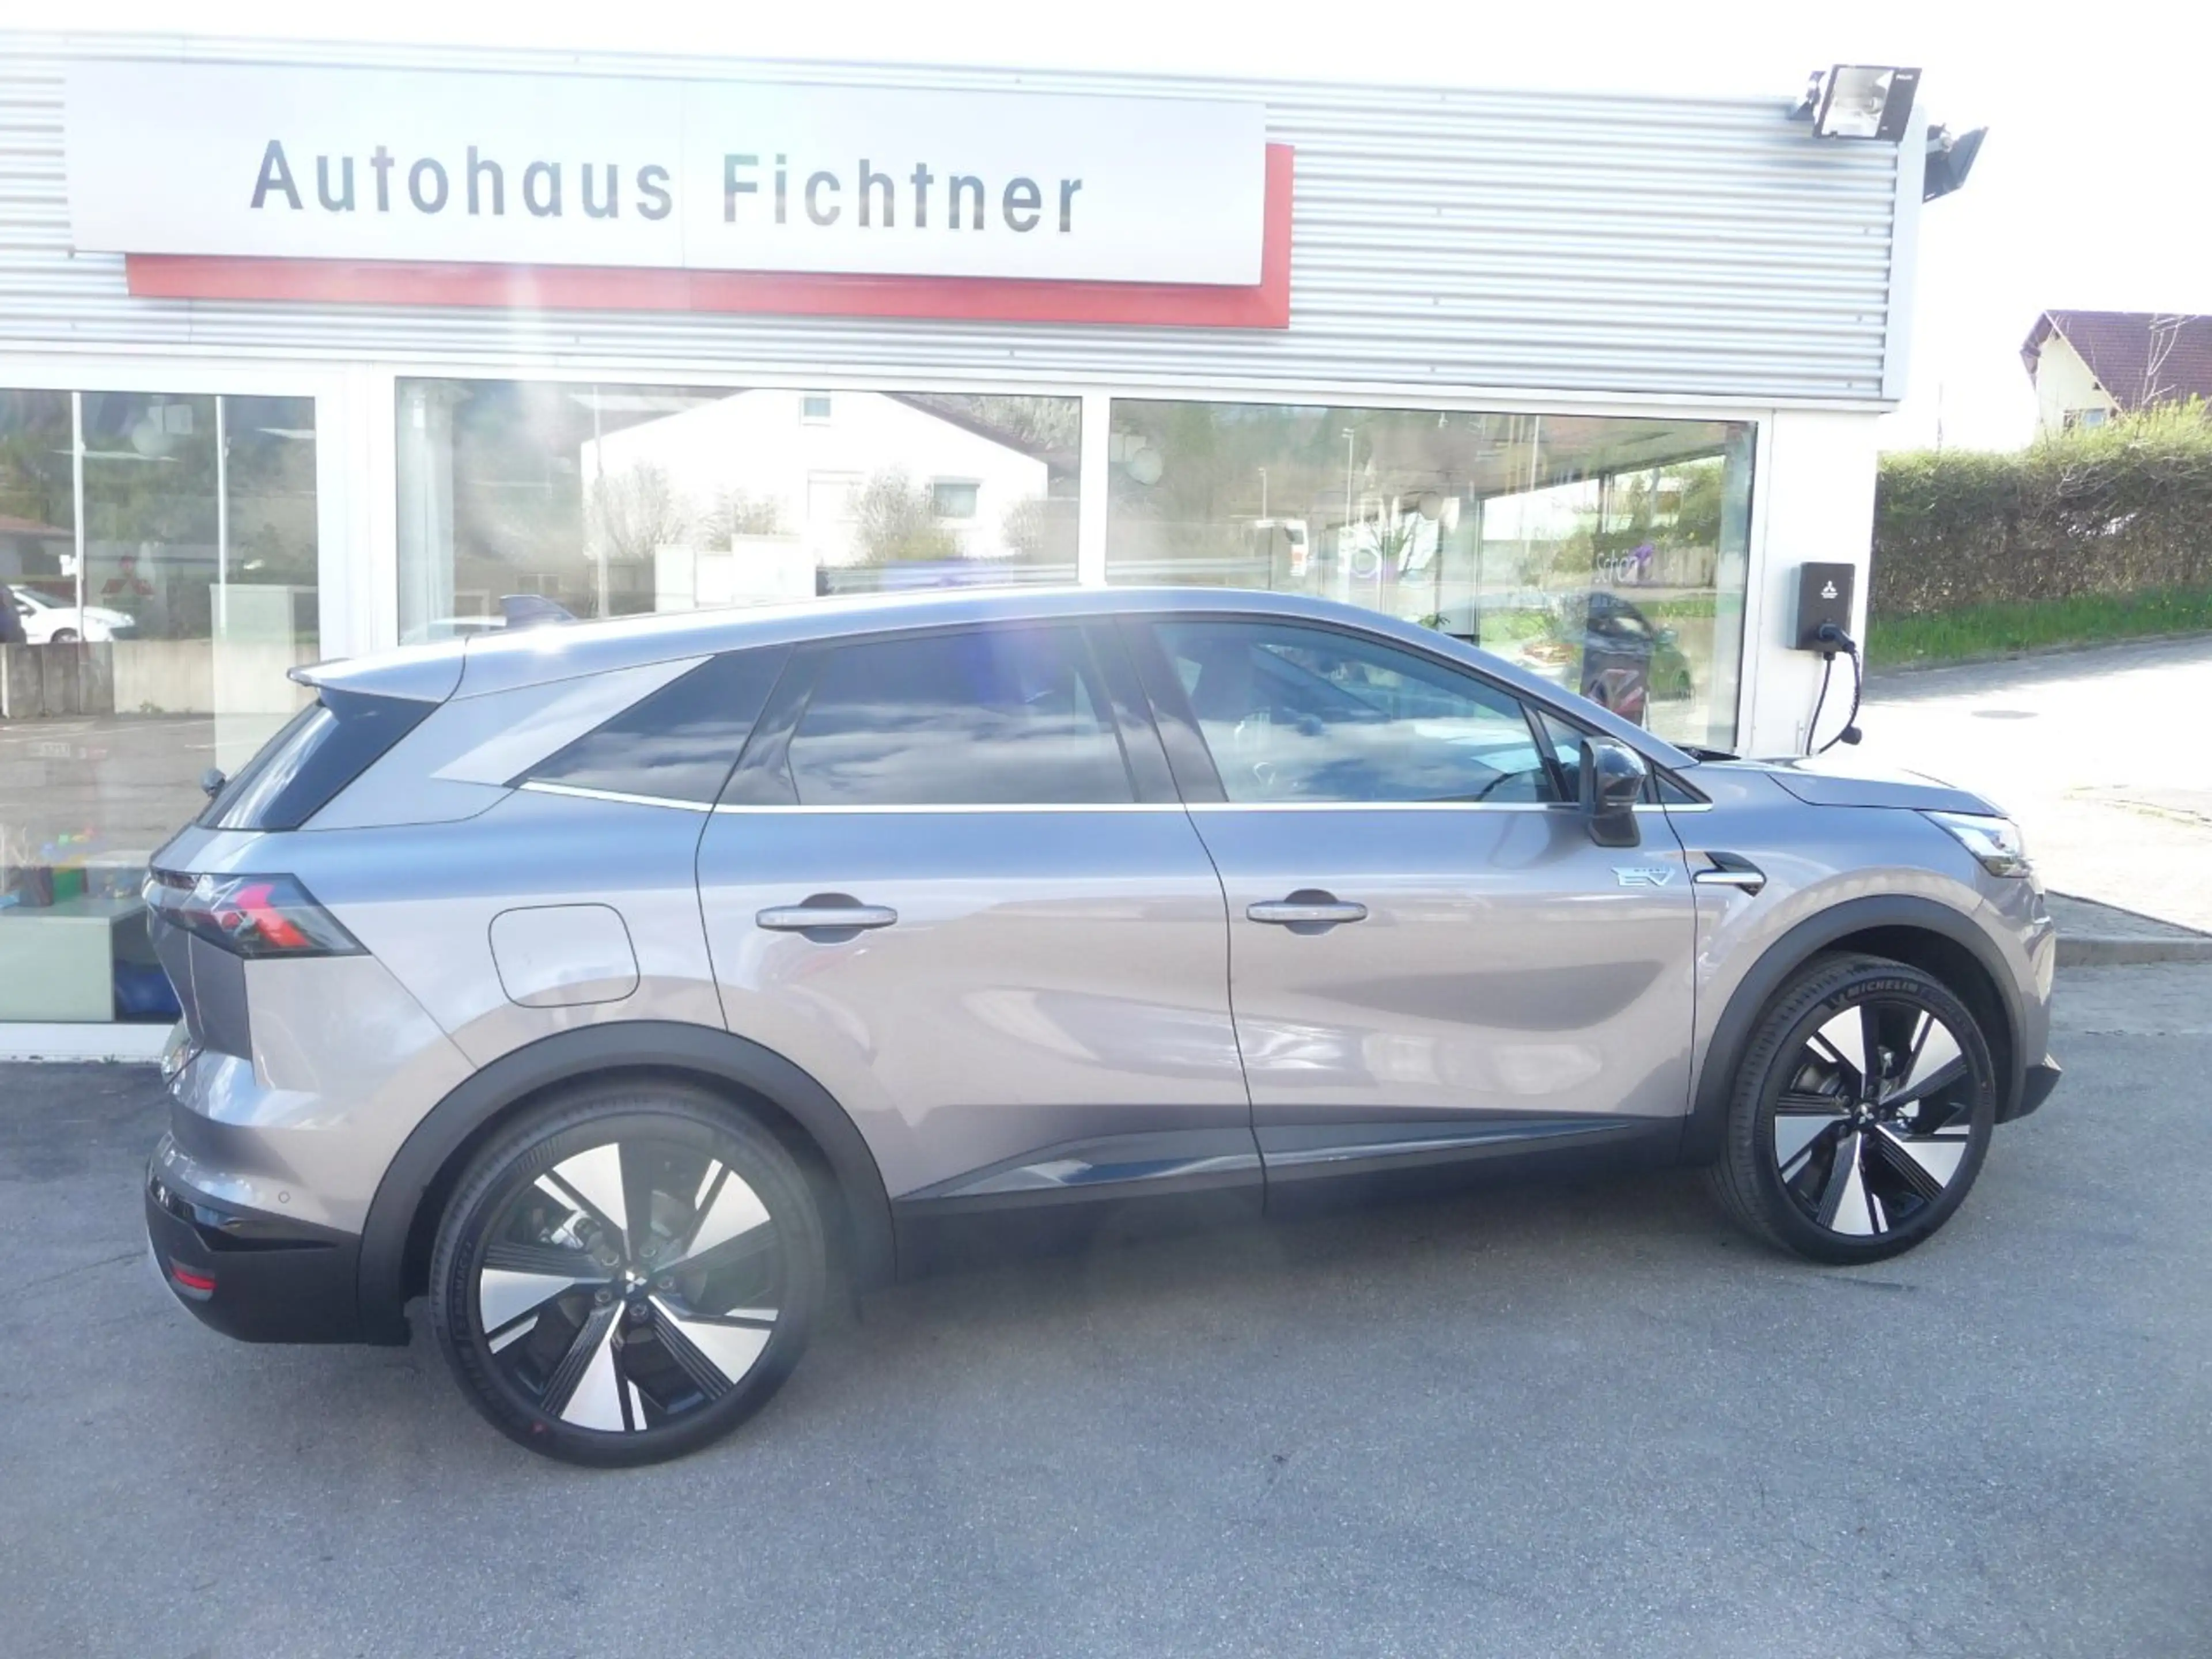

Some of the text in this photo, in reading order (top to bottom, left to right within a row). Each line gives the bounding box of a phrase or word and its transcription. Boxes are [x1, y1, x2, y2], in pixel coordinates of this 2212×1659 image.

[250, 139, 1082, 232] Autohaus Fichtner
[1846, 979, 1919, 998] MICHELIN
